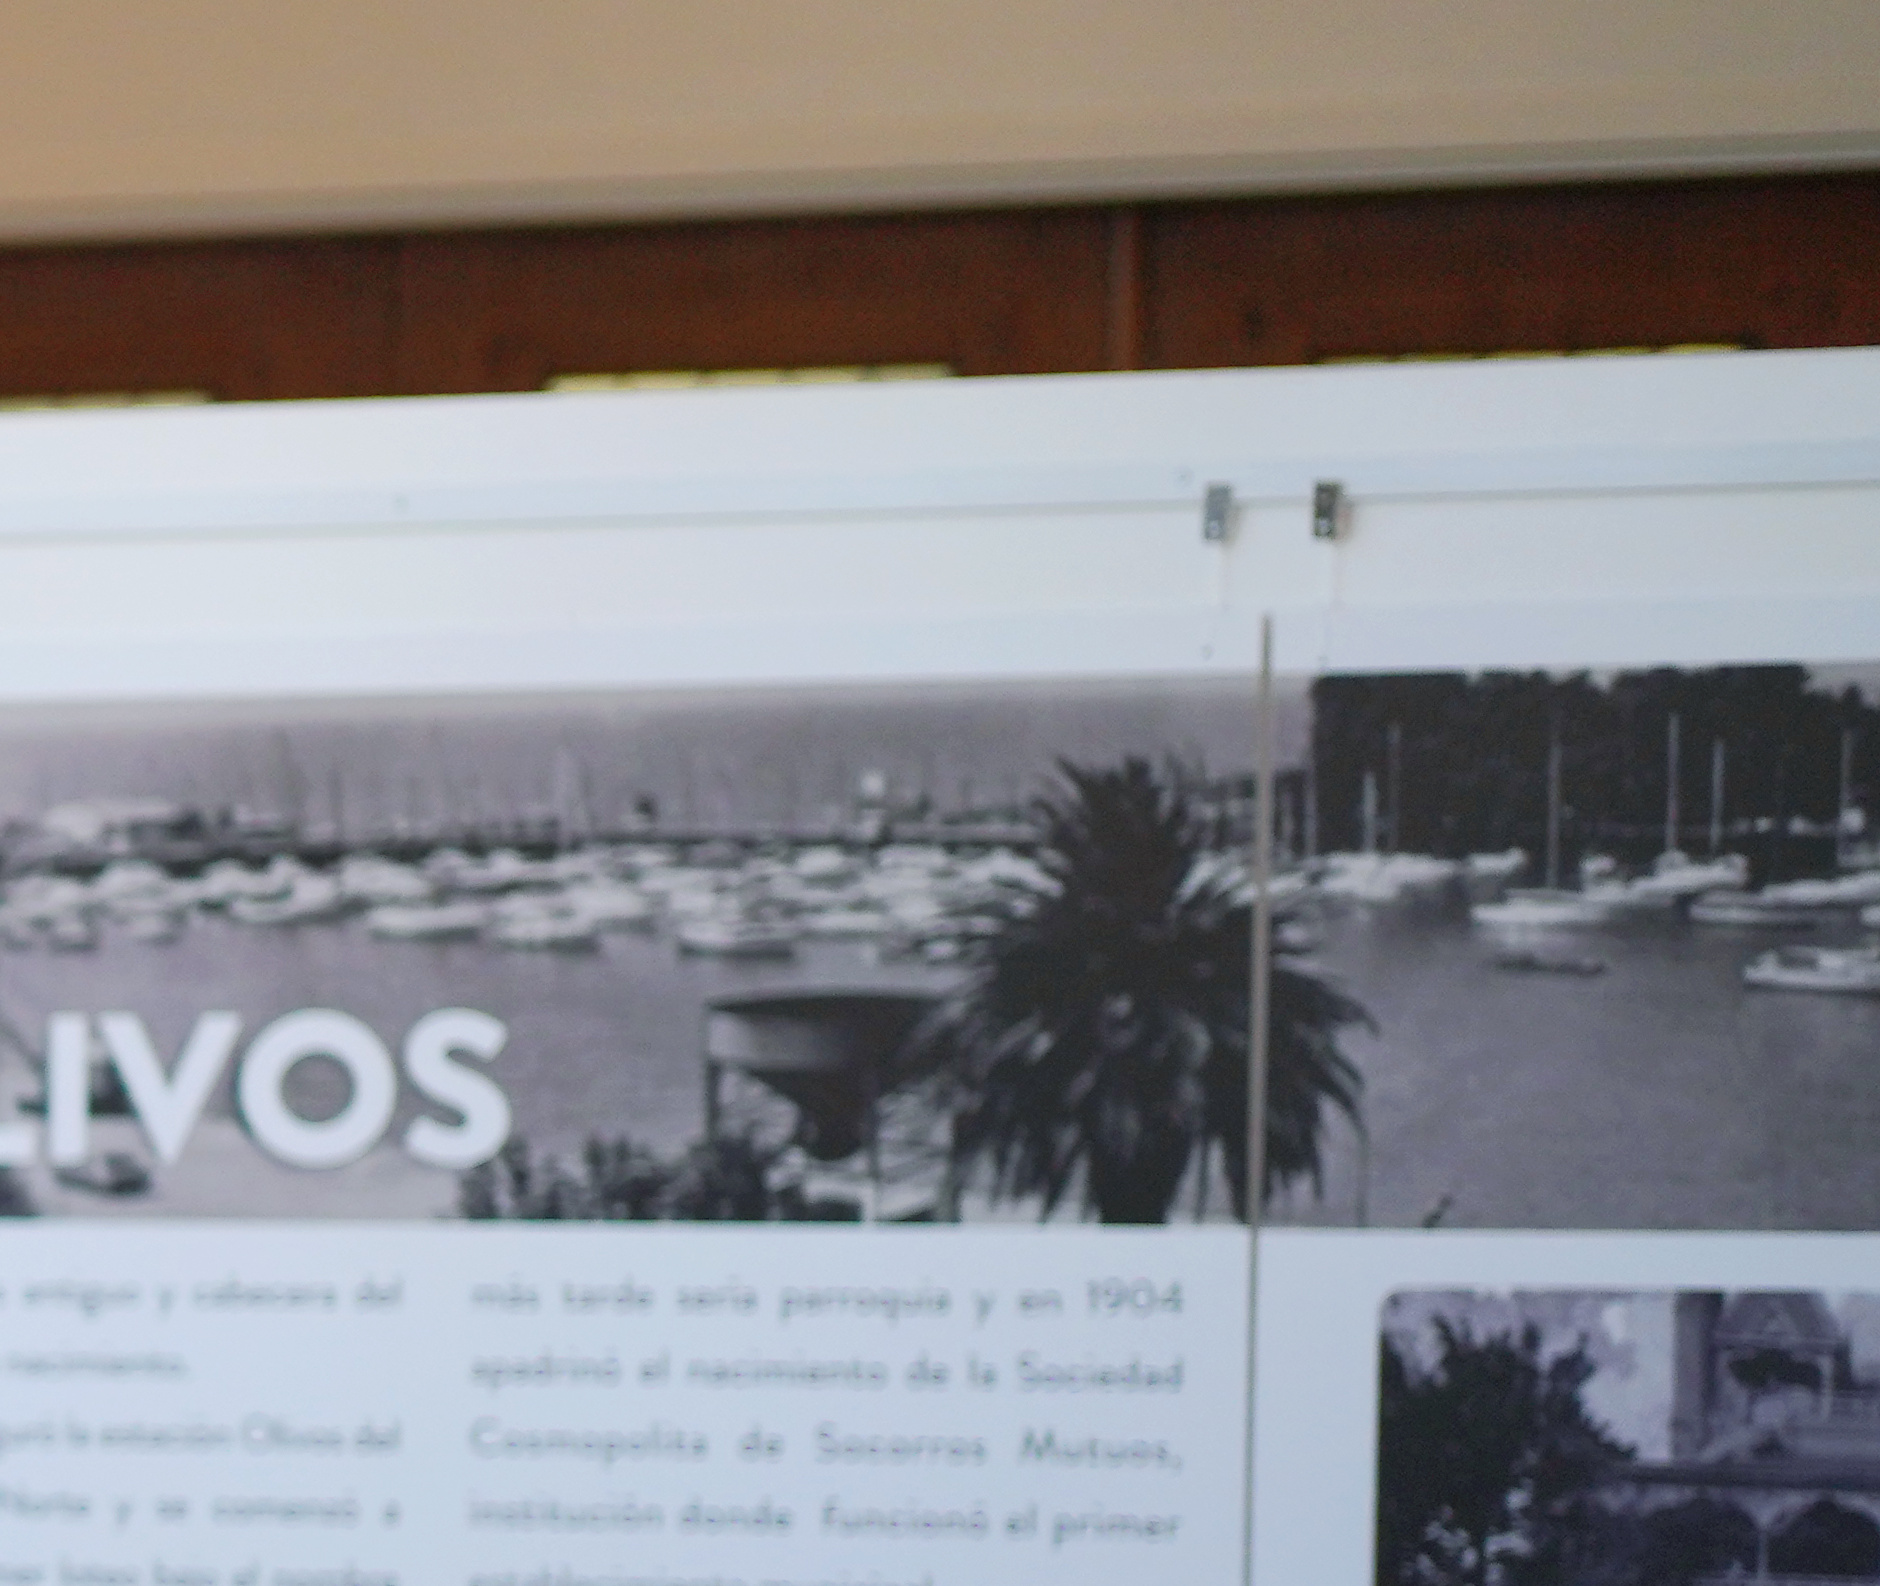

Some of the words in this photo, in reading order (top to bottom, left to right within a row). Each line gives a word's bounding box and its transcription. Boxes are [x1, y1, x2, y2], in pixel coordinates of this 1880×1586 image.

[468, 1273, 542, 1314] más
[560, 1274, 656, 1314] tarde
[674, 1275, 760, 1316] sería
[777, 1280, 954, 1326] parroquia
[972, 1290, 997, 1327] y
[1015, 1289, 1065, 1318] en
[1085, 1276, 1186, 1318] 1904
[469, 1347, 623, 1394] apadrinó
[637, 1347, 671, 1386] el
[684, 1350, 890, 1391] nacimiento
[903, 1350, 951, 1391] de
[966, 1350, 1000, 1392] la
[1015, 1349, 1186, 1393] Sociedad
[466, 1415, 710, 1469] Cosmopolita
[737, 1423, 785, 1463] de
[813, 1419, 989, 1466] Socorros
[1017, 1425, 1185, 1473] Mutuos,
[466, 1493, 666, 1533] institución
[677, 1496, 795, 1536] donde
[820, 1494, 991, 1541] funcionó
[1002, 1500, 1040, 1540] el
[1051, 1502, 1182, 1551] primer
